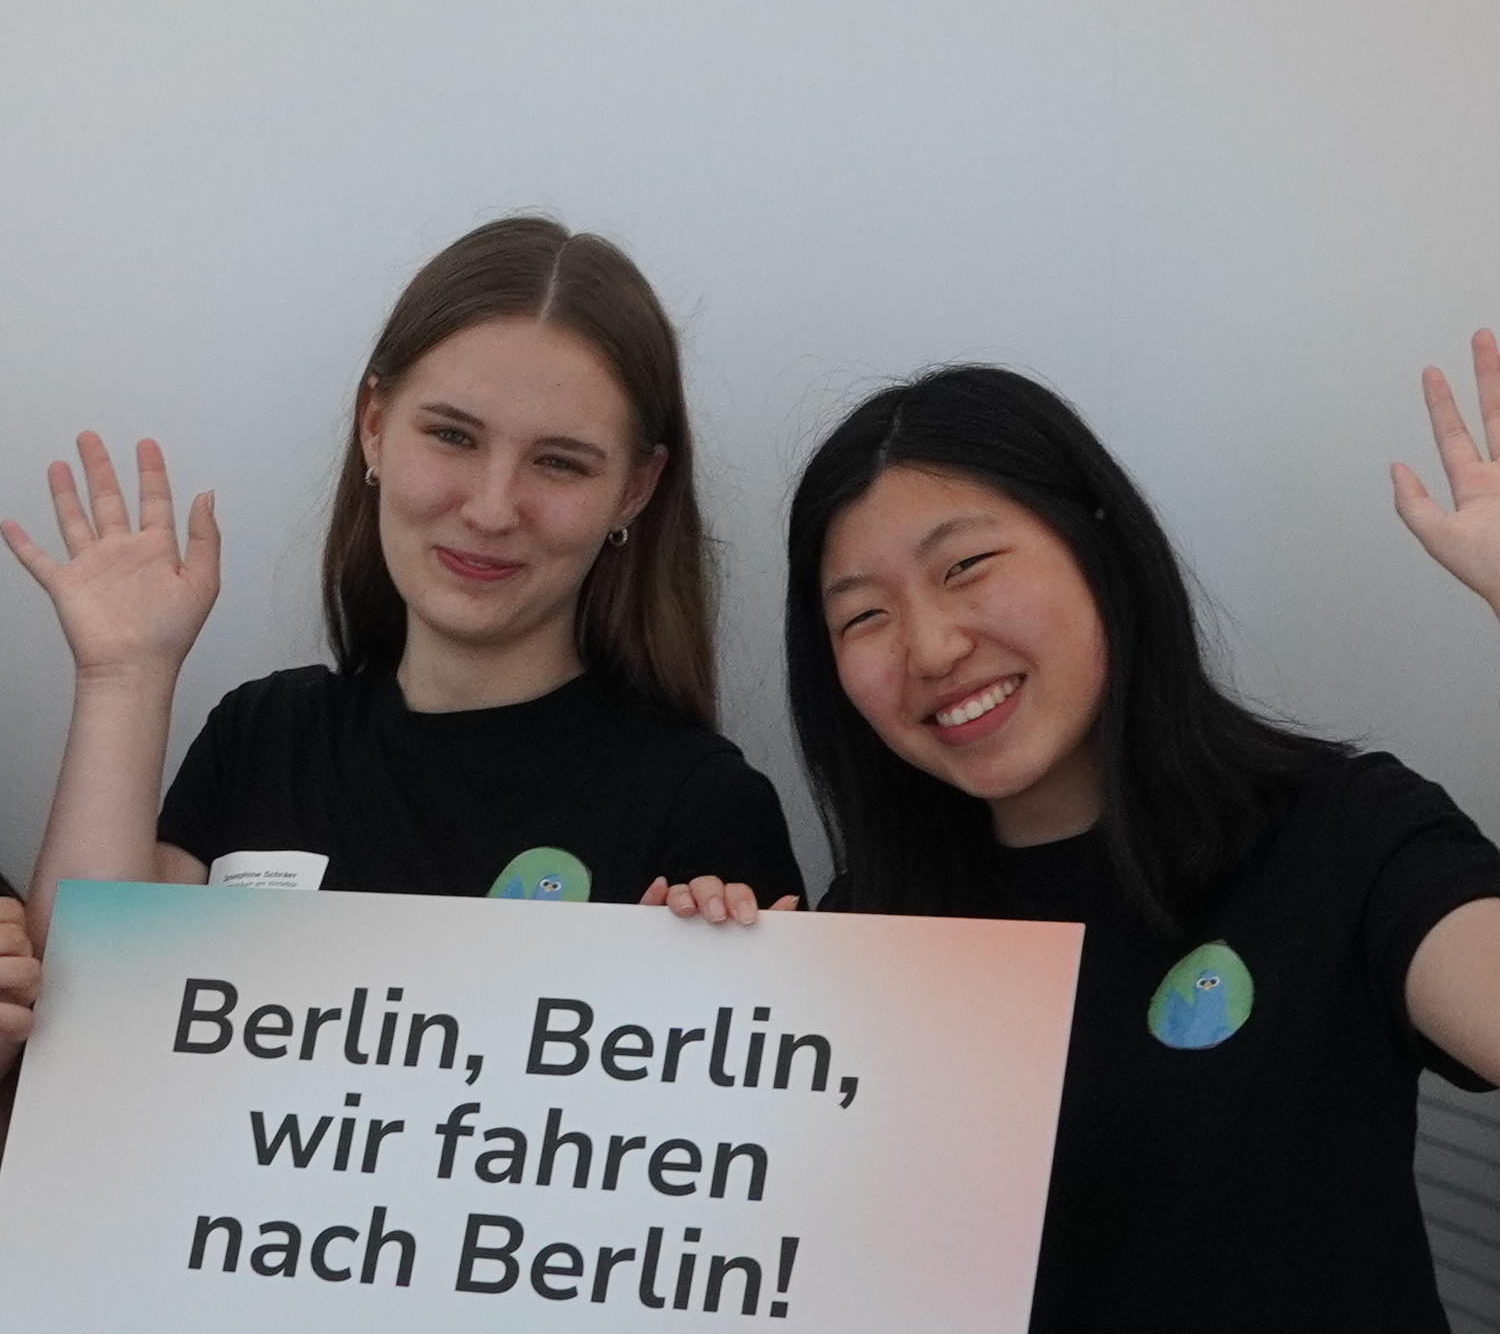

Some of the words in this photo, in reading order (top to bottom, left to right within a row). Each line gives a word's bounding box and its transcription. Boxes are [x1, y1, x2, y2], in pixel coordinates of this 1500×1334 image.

[172, 977, 485, 1087] Berlin,
[525, 996, 861, 1110] Berlin,
[249, 1092, 405, 1175] wir
[434, 1103, 769, 1202] fahren
[187, 1205, 417, 1288] nach
[454, 1212, 801, 1319] Berlin!
